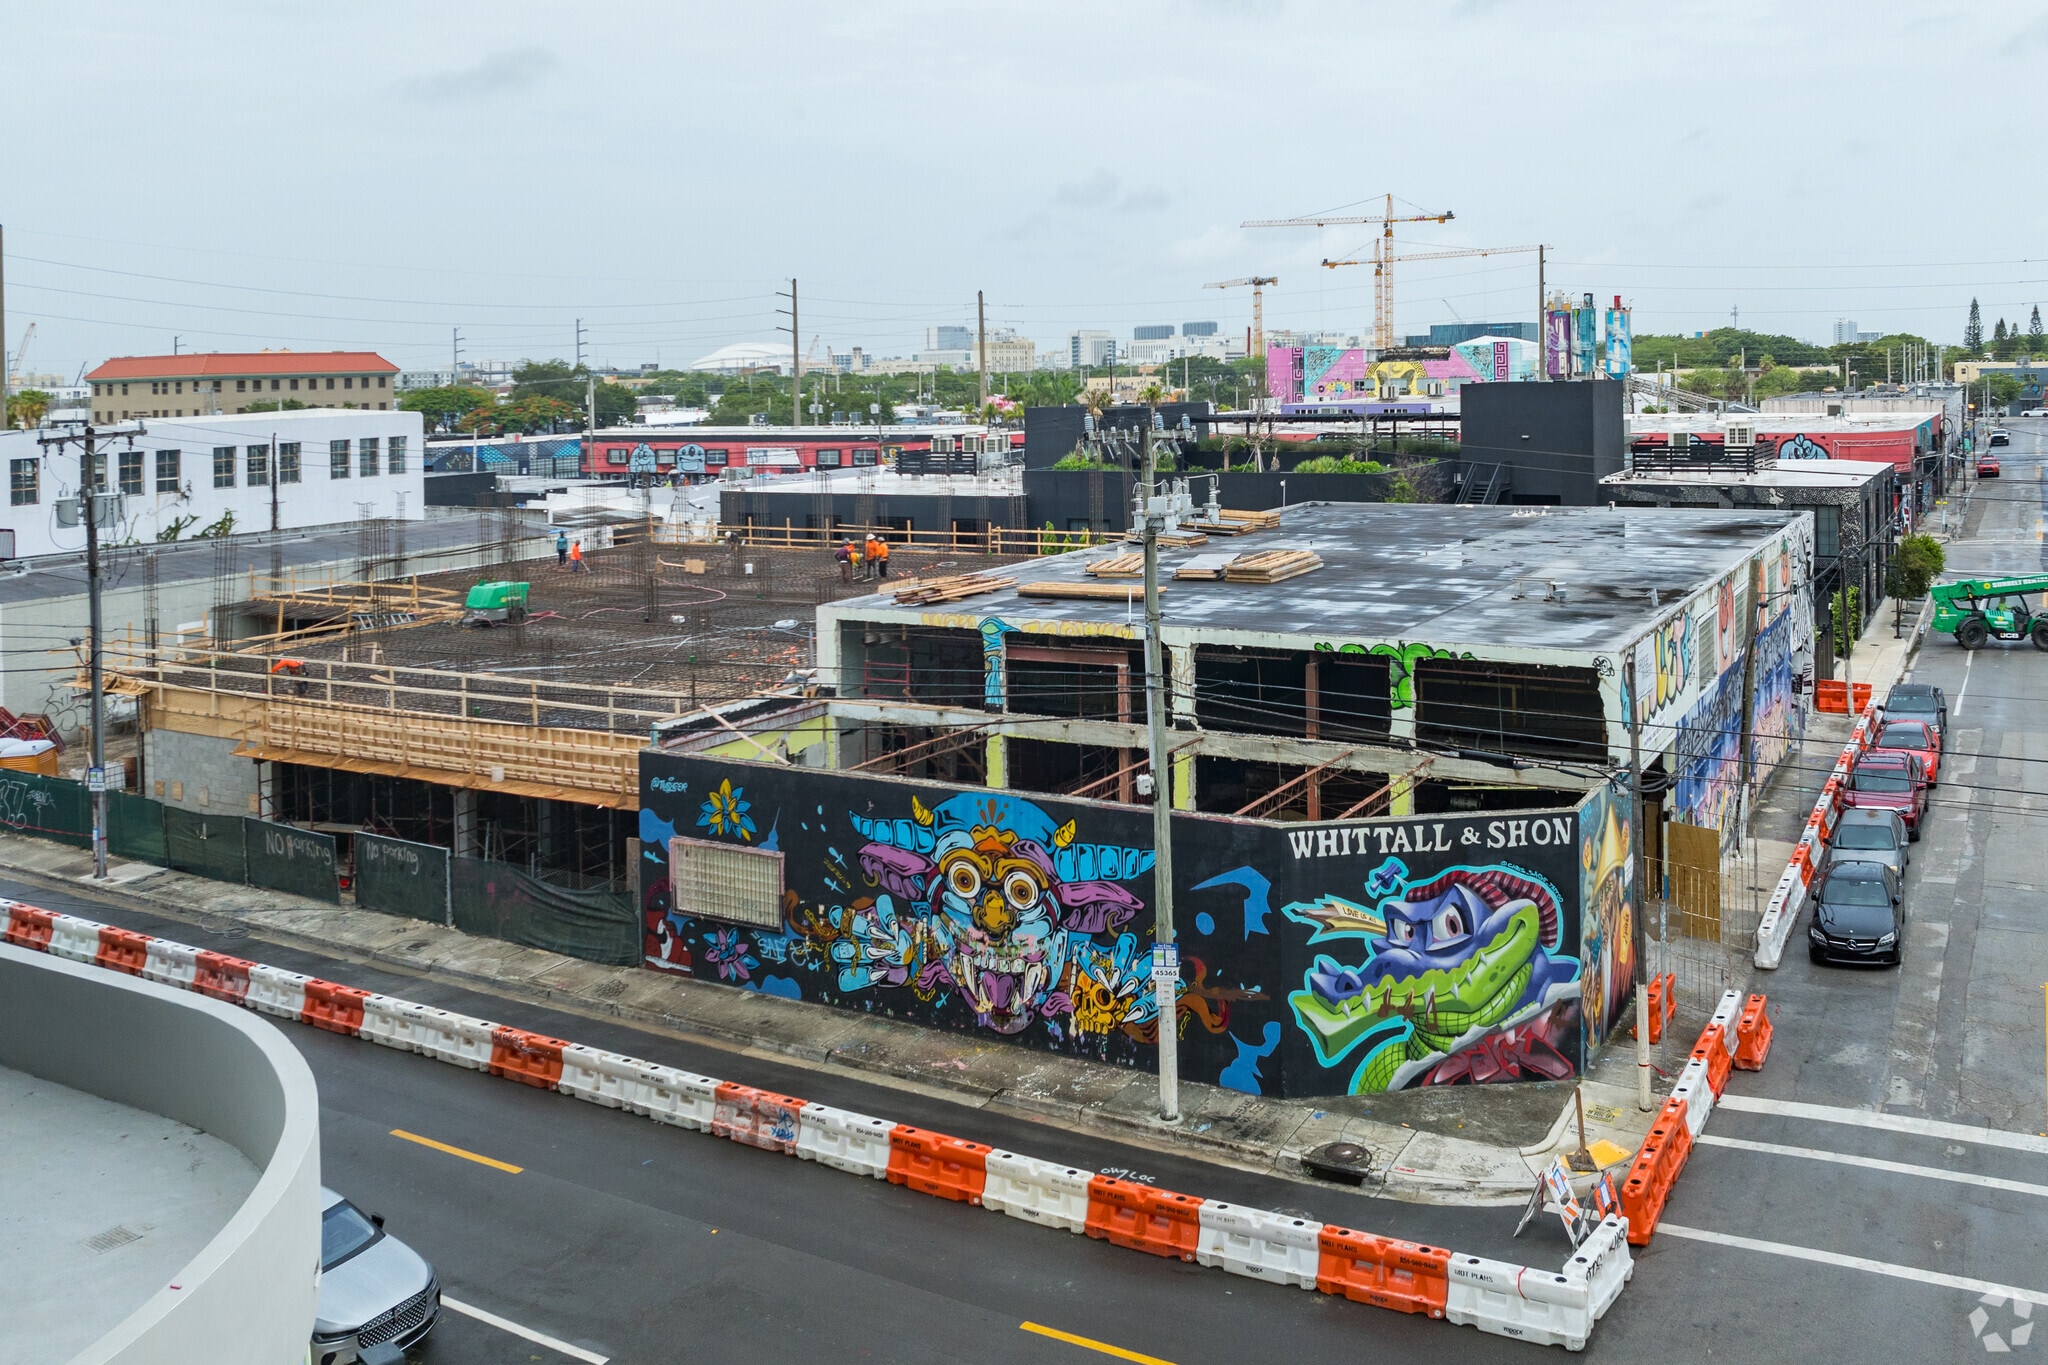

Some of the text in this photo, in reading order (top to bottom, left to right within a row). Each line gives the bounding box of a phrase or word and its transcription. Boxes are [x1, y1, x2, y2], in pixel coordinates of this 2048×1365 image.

[265, 831, 285, 855] NO
[1288, 817, 1573, 860] WHITTALL & SHON
[382, 845, 419, 875] parking
